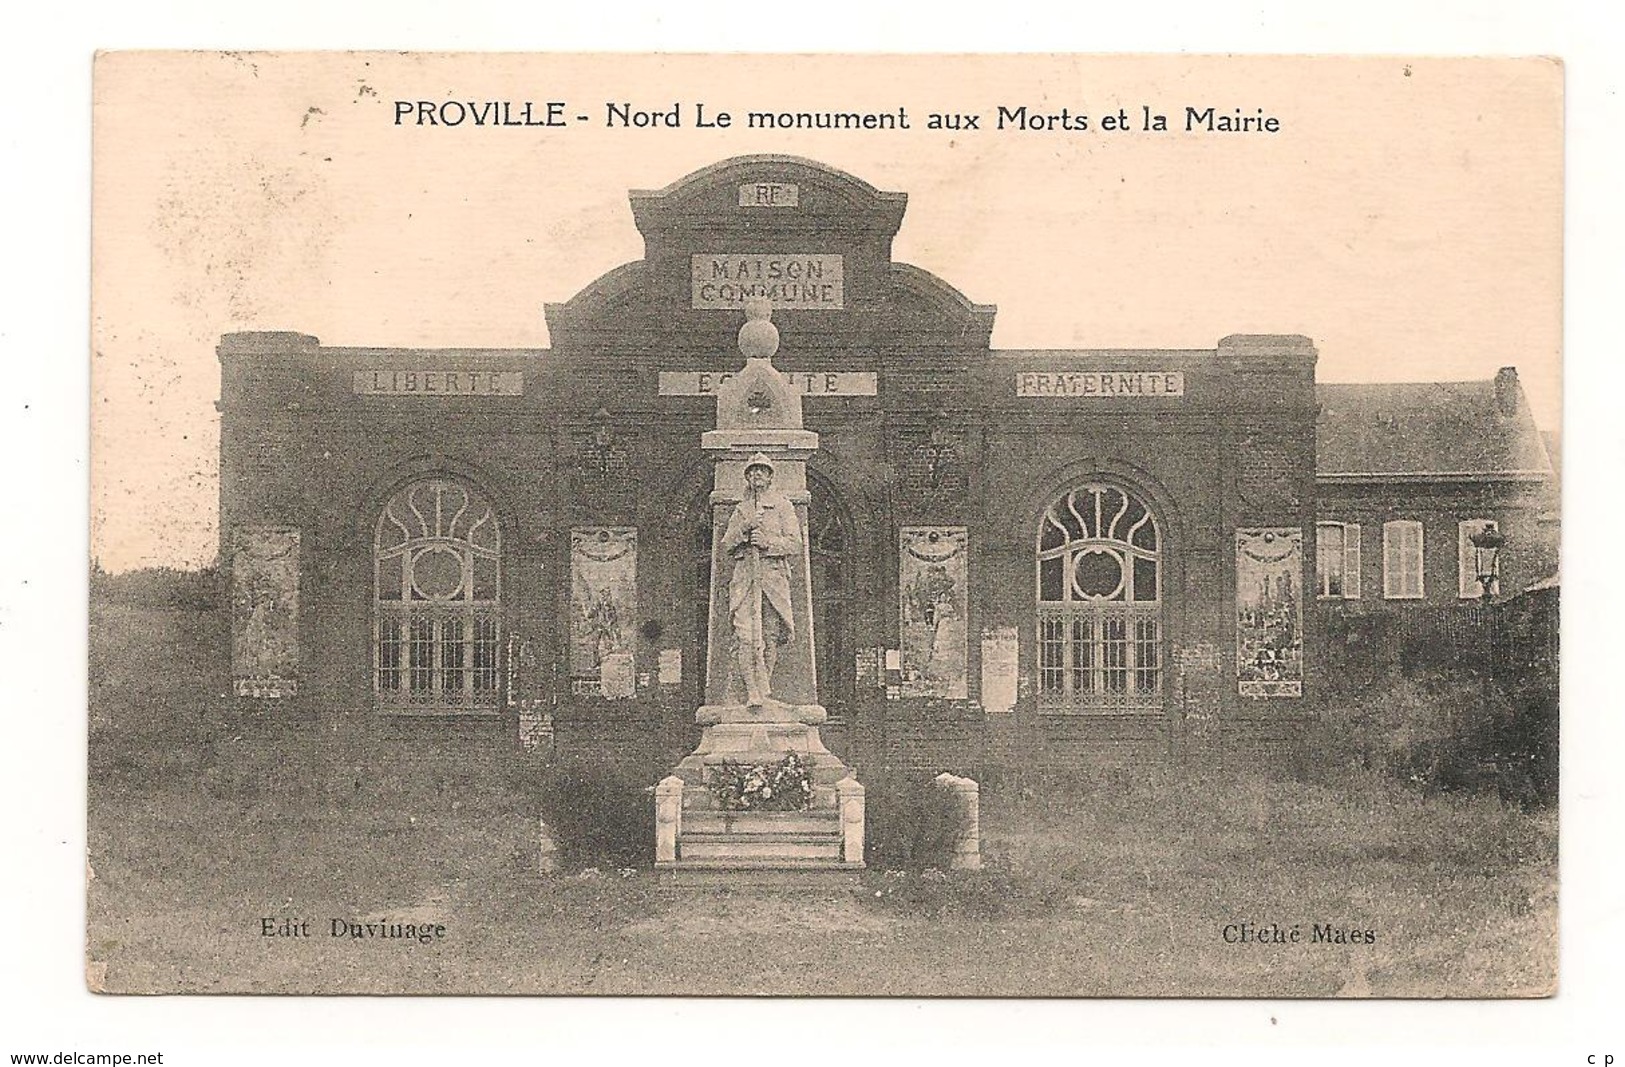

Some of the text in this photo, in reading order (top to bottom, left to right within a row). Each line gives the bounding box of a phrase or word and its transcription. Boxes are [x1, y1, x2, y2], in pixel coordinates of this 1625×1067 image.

[606, 103, 681, 128] Nord
[695, 103, 732, 129] Le
[747, 106, 911, 130] monument
[927, 113, 980, 131] aux
[997, 106, 1088, 131] Morts
[1101, 108, 1131, 131] et
[1142, 105, 1168, 131] la
[1185, 106, 1280, 133] Mairie
[712, 260, 823, 279] MAISON
[700, 284, 834, 302] COMMUNE
[699, 374, 838, 393] EITE
[1021, 374, 1177, 393] FRATERNITE
[261, 917, 446, 941] Edit Duvinage
[1222, 922, 1376, 945] Cliché Maes
